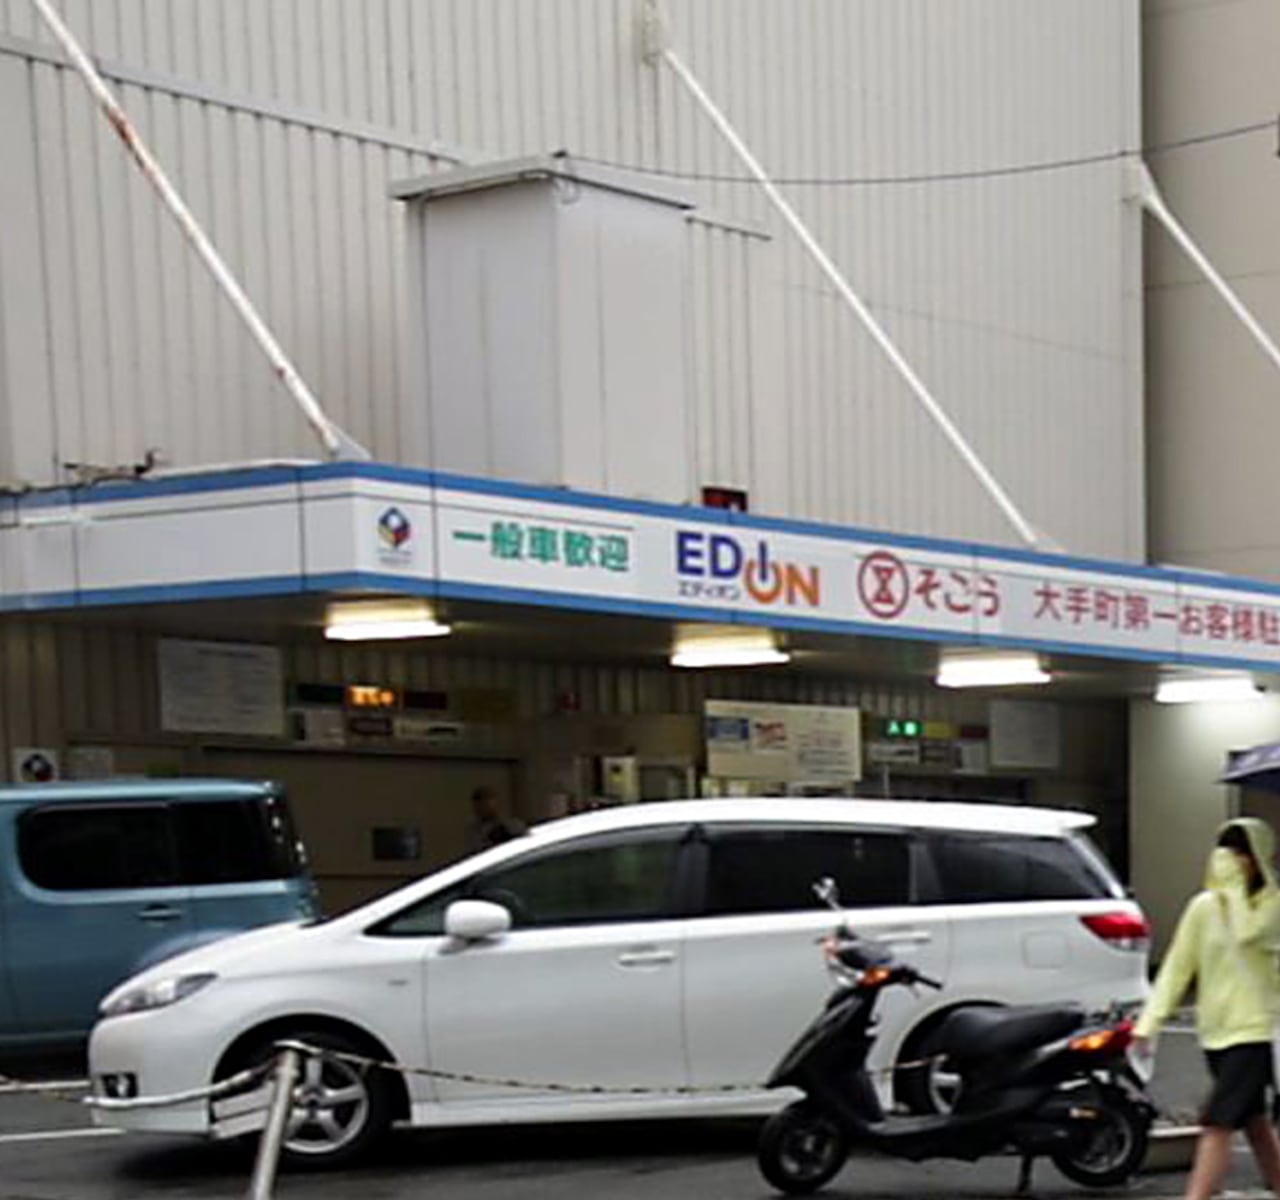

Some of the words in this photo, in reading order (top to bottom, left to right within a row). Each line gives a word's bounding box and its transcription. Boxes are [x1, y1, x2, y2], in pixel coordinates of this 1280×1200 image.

[452, 520, 630, 573] 一般車歓迎
[675, 530, 820, 607] EDION
[912, 567, 1000, 618] そこう
